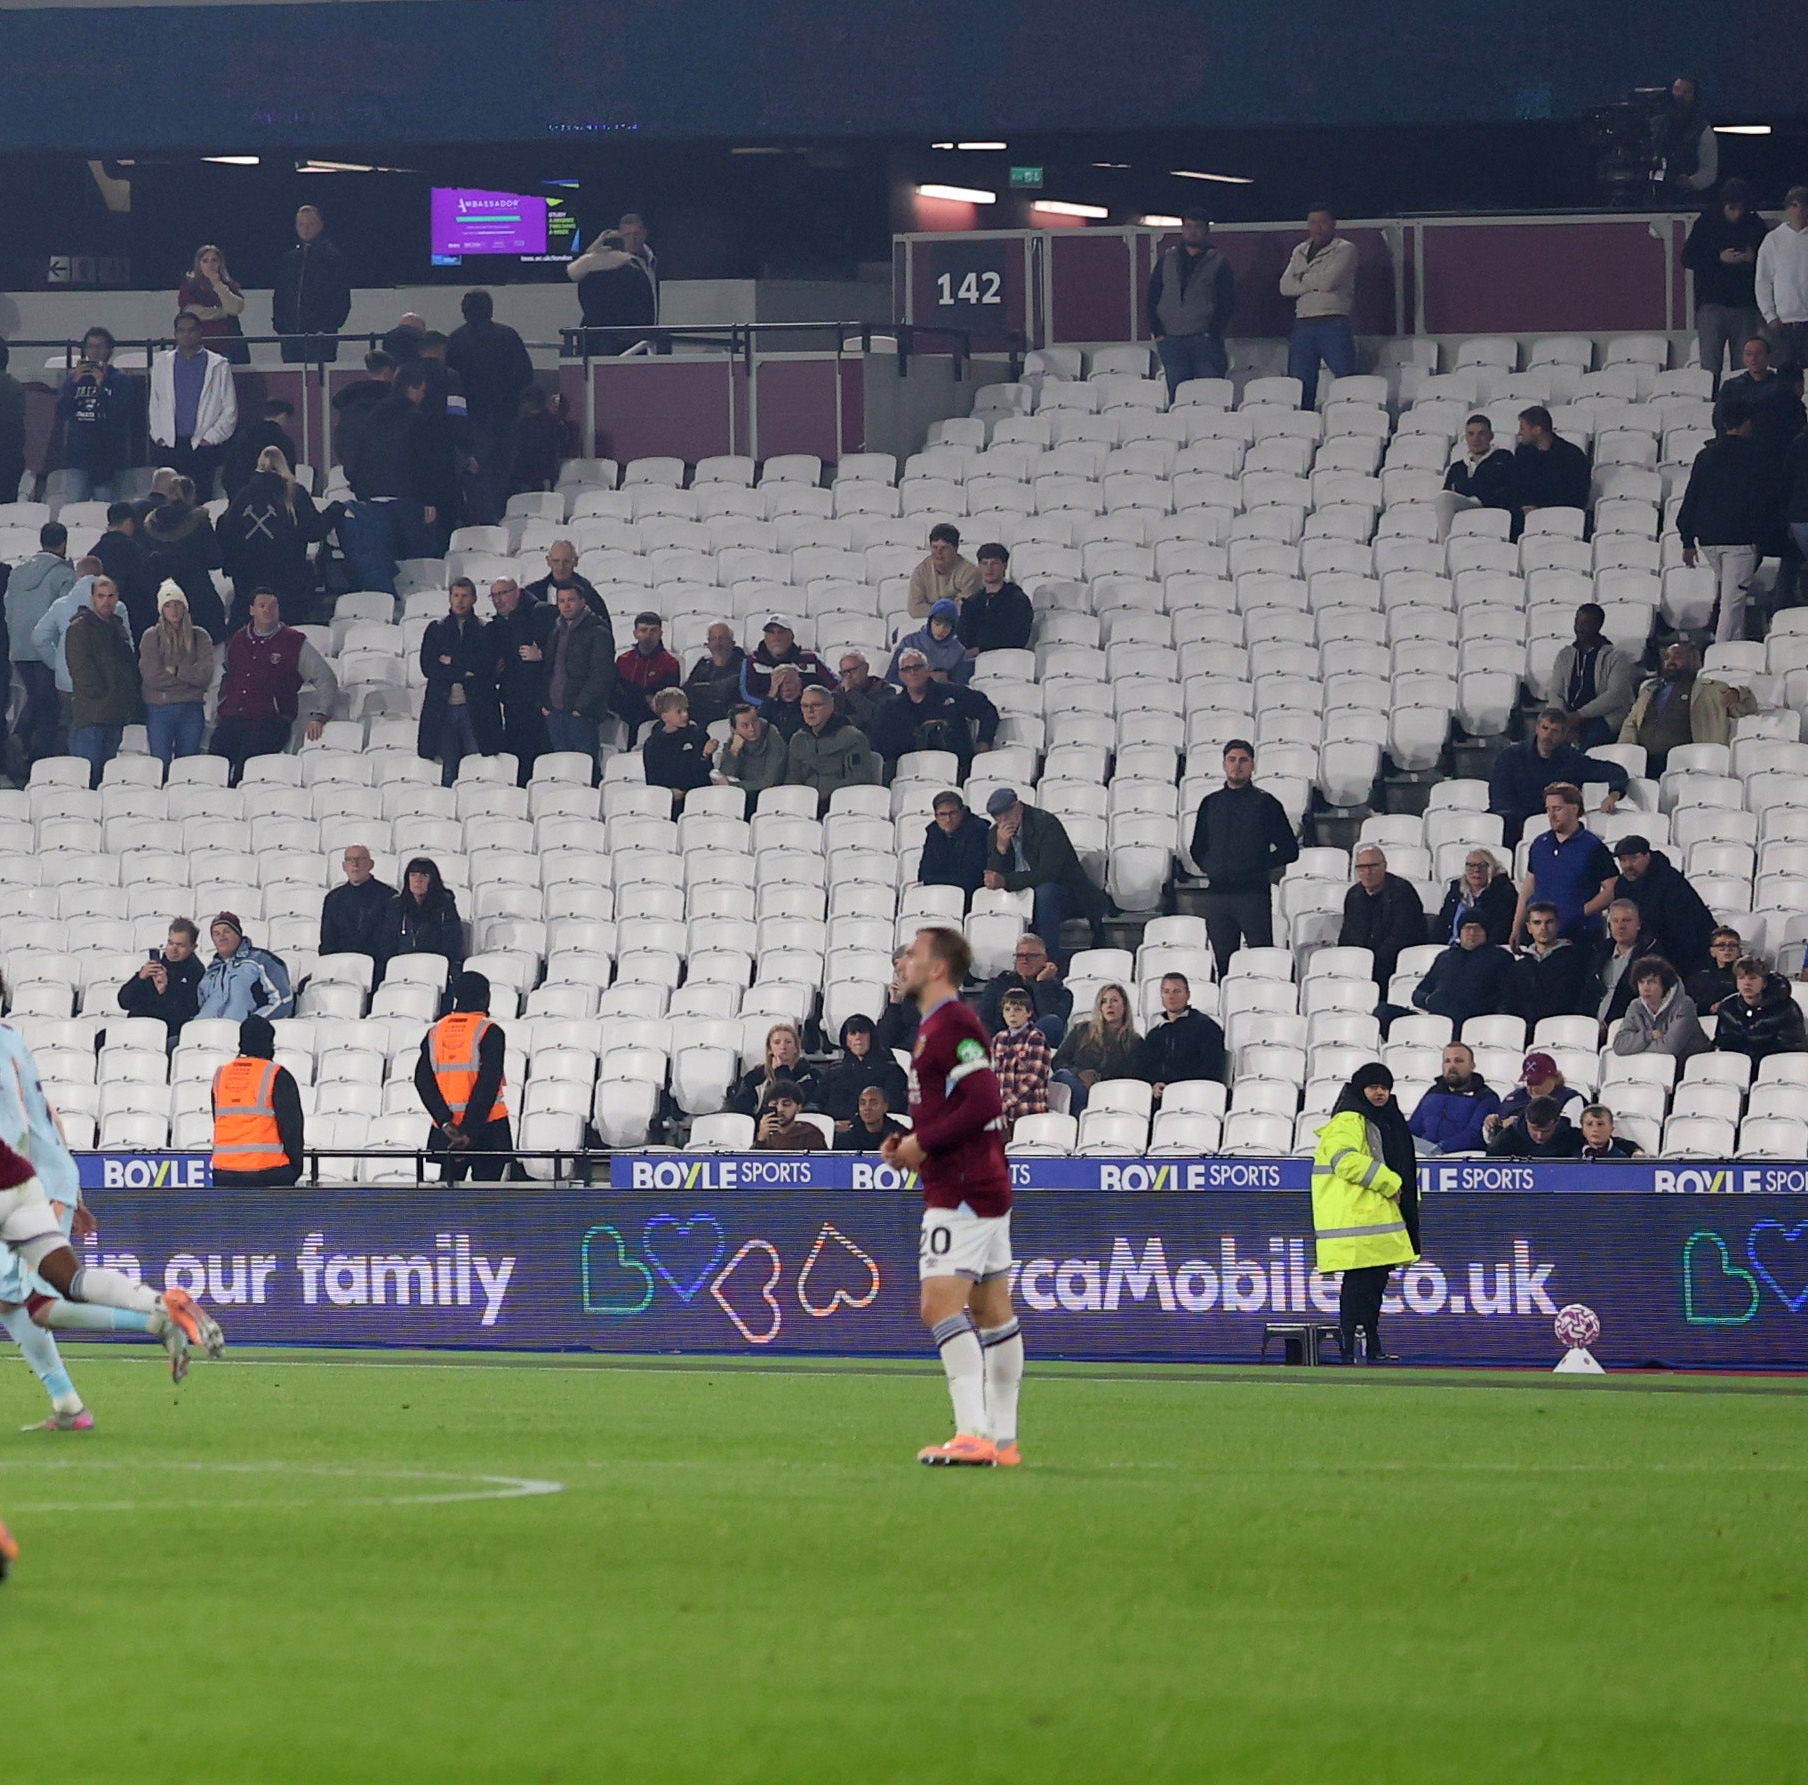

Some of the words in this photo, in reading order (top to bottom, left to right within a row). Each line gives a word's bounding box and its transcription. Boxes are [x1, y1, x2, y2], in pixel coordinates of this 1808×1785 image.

[937, 271, 1002, 305] 142
[103, 1160, 204, 1187] BOYLE
[633, 1162, 737, 1189] BOYLE
[741, 1163, 811, 1183] SPORTS
[852, 1163, 919, 1189] BOY
[1100, 1165, 1205, 1191] BOYLE
[1209, 1164, 1280, 1187] SPORTS
[1462, 1168, 1534, 1190] SPORTS
[1655, 1170, 1761, 1193] BOYLE
[1766, 1170, 1808, 1192] SPO
[164, 1254, 277, 1305] our
[297, 1233, 517, 1326] family
[1007, 1235, 1558, 1316] caMobileo.uk
